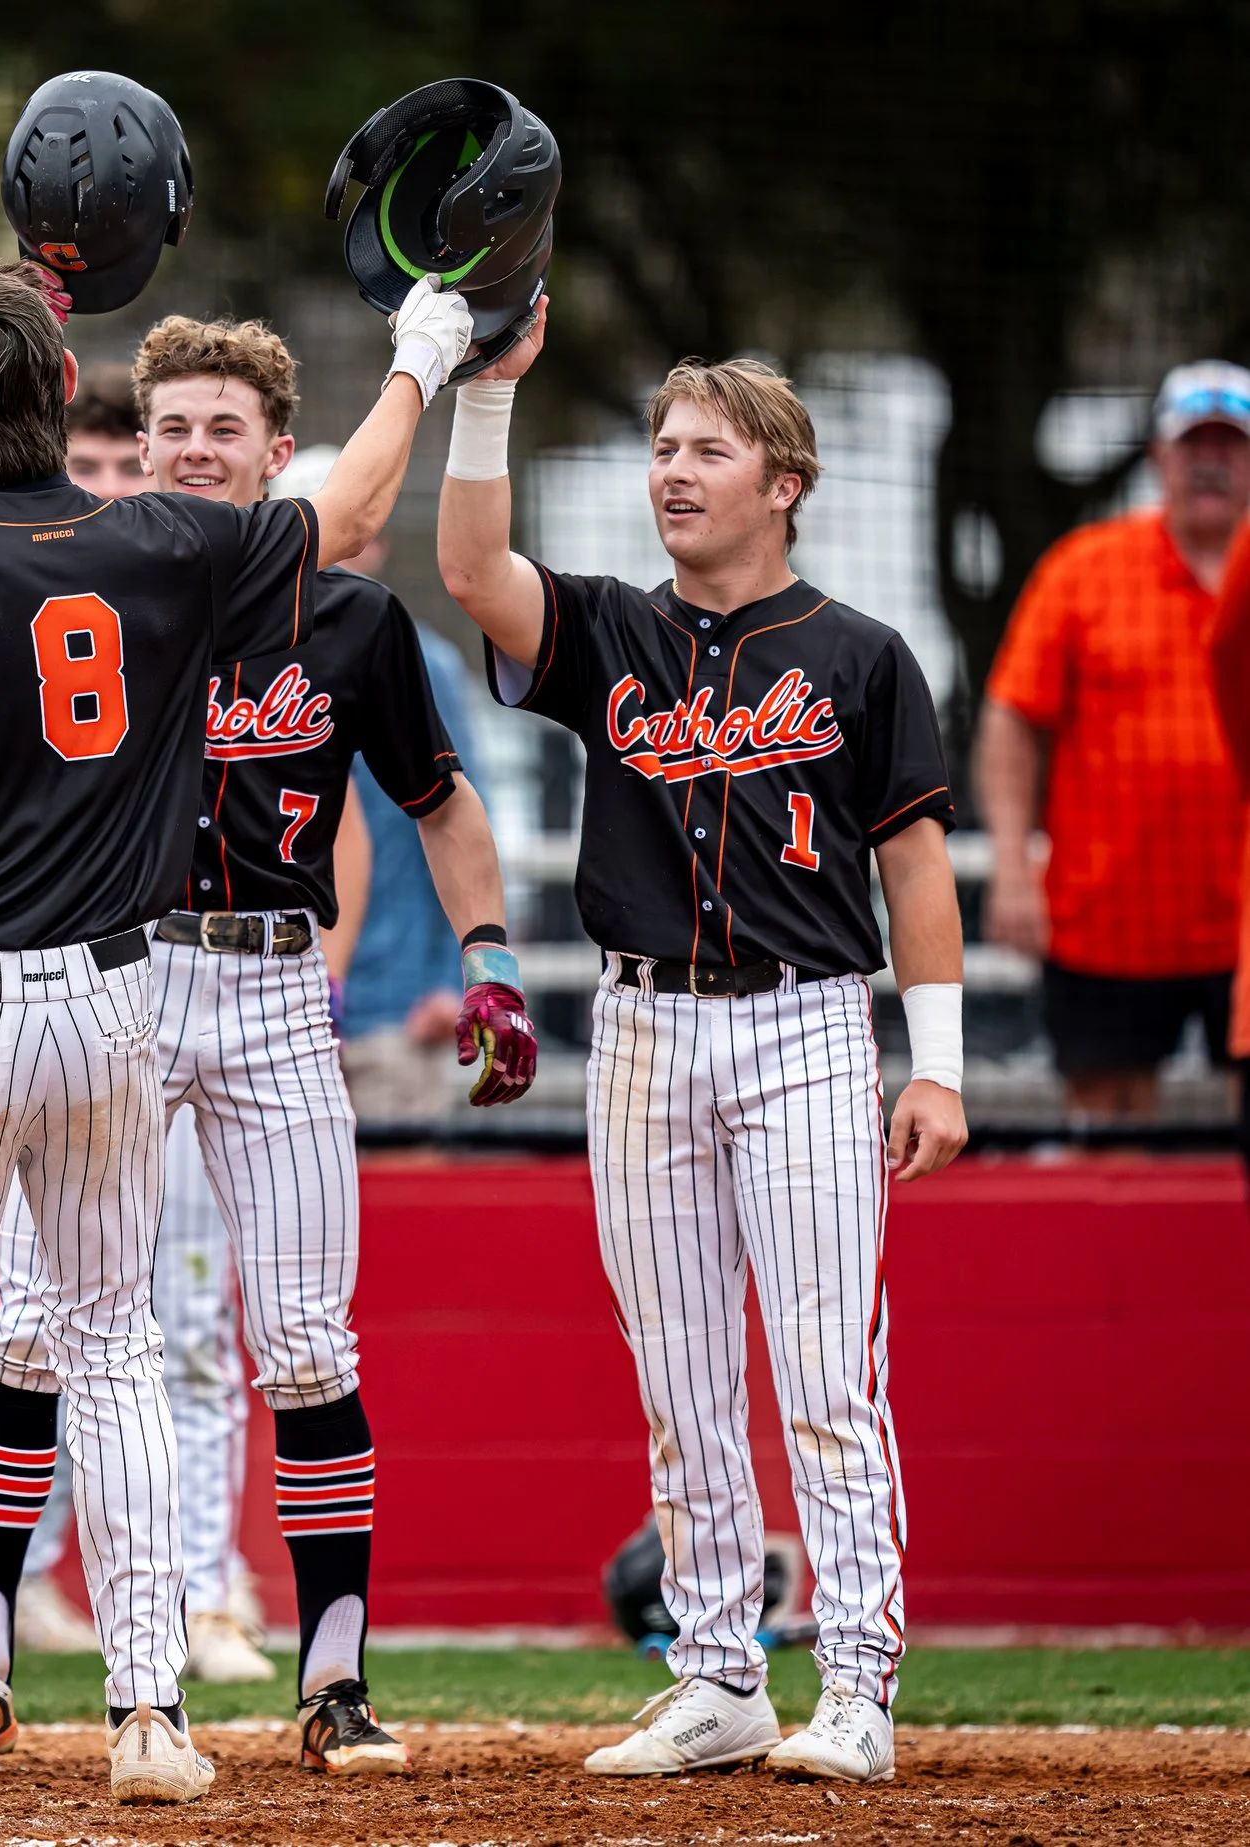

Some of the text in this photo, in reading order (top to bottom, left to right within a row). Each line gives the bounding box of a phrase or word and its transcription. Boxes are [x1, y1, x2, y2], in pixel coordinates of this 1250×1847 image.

[167, 180, 176, 212] marucci
[40, 242, 88, 271] C
[32, 528, 75, 542] marucci
[30, 592, 129, 761] 8
[607, 667, 839, 758] Catholic
[279, 788, 320, 864] 7
[780, 791, 821, 872] 1
[23, 967, 65, 983] marucci
[672, 1712, 719, 1748] marucci
